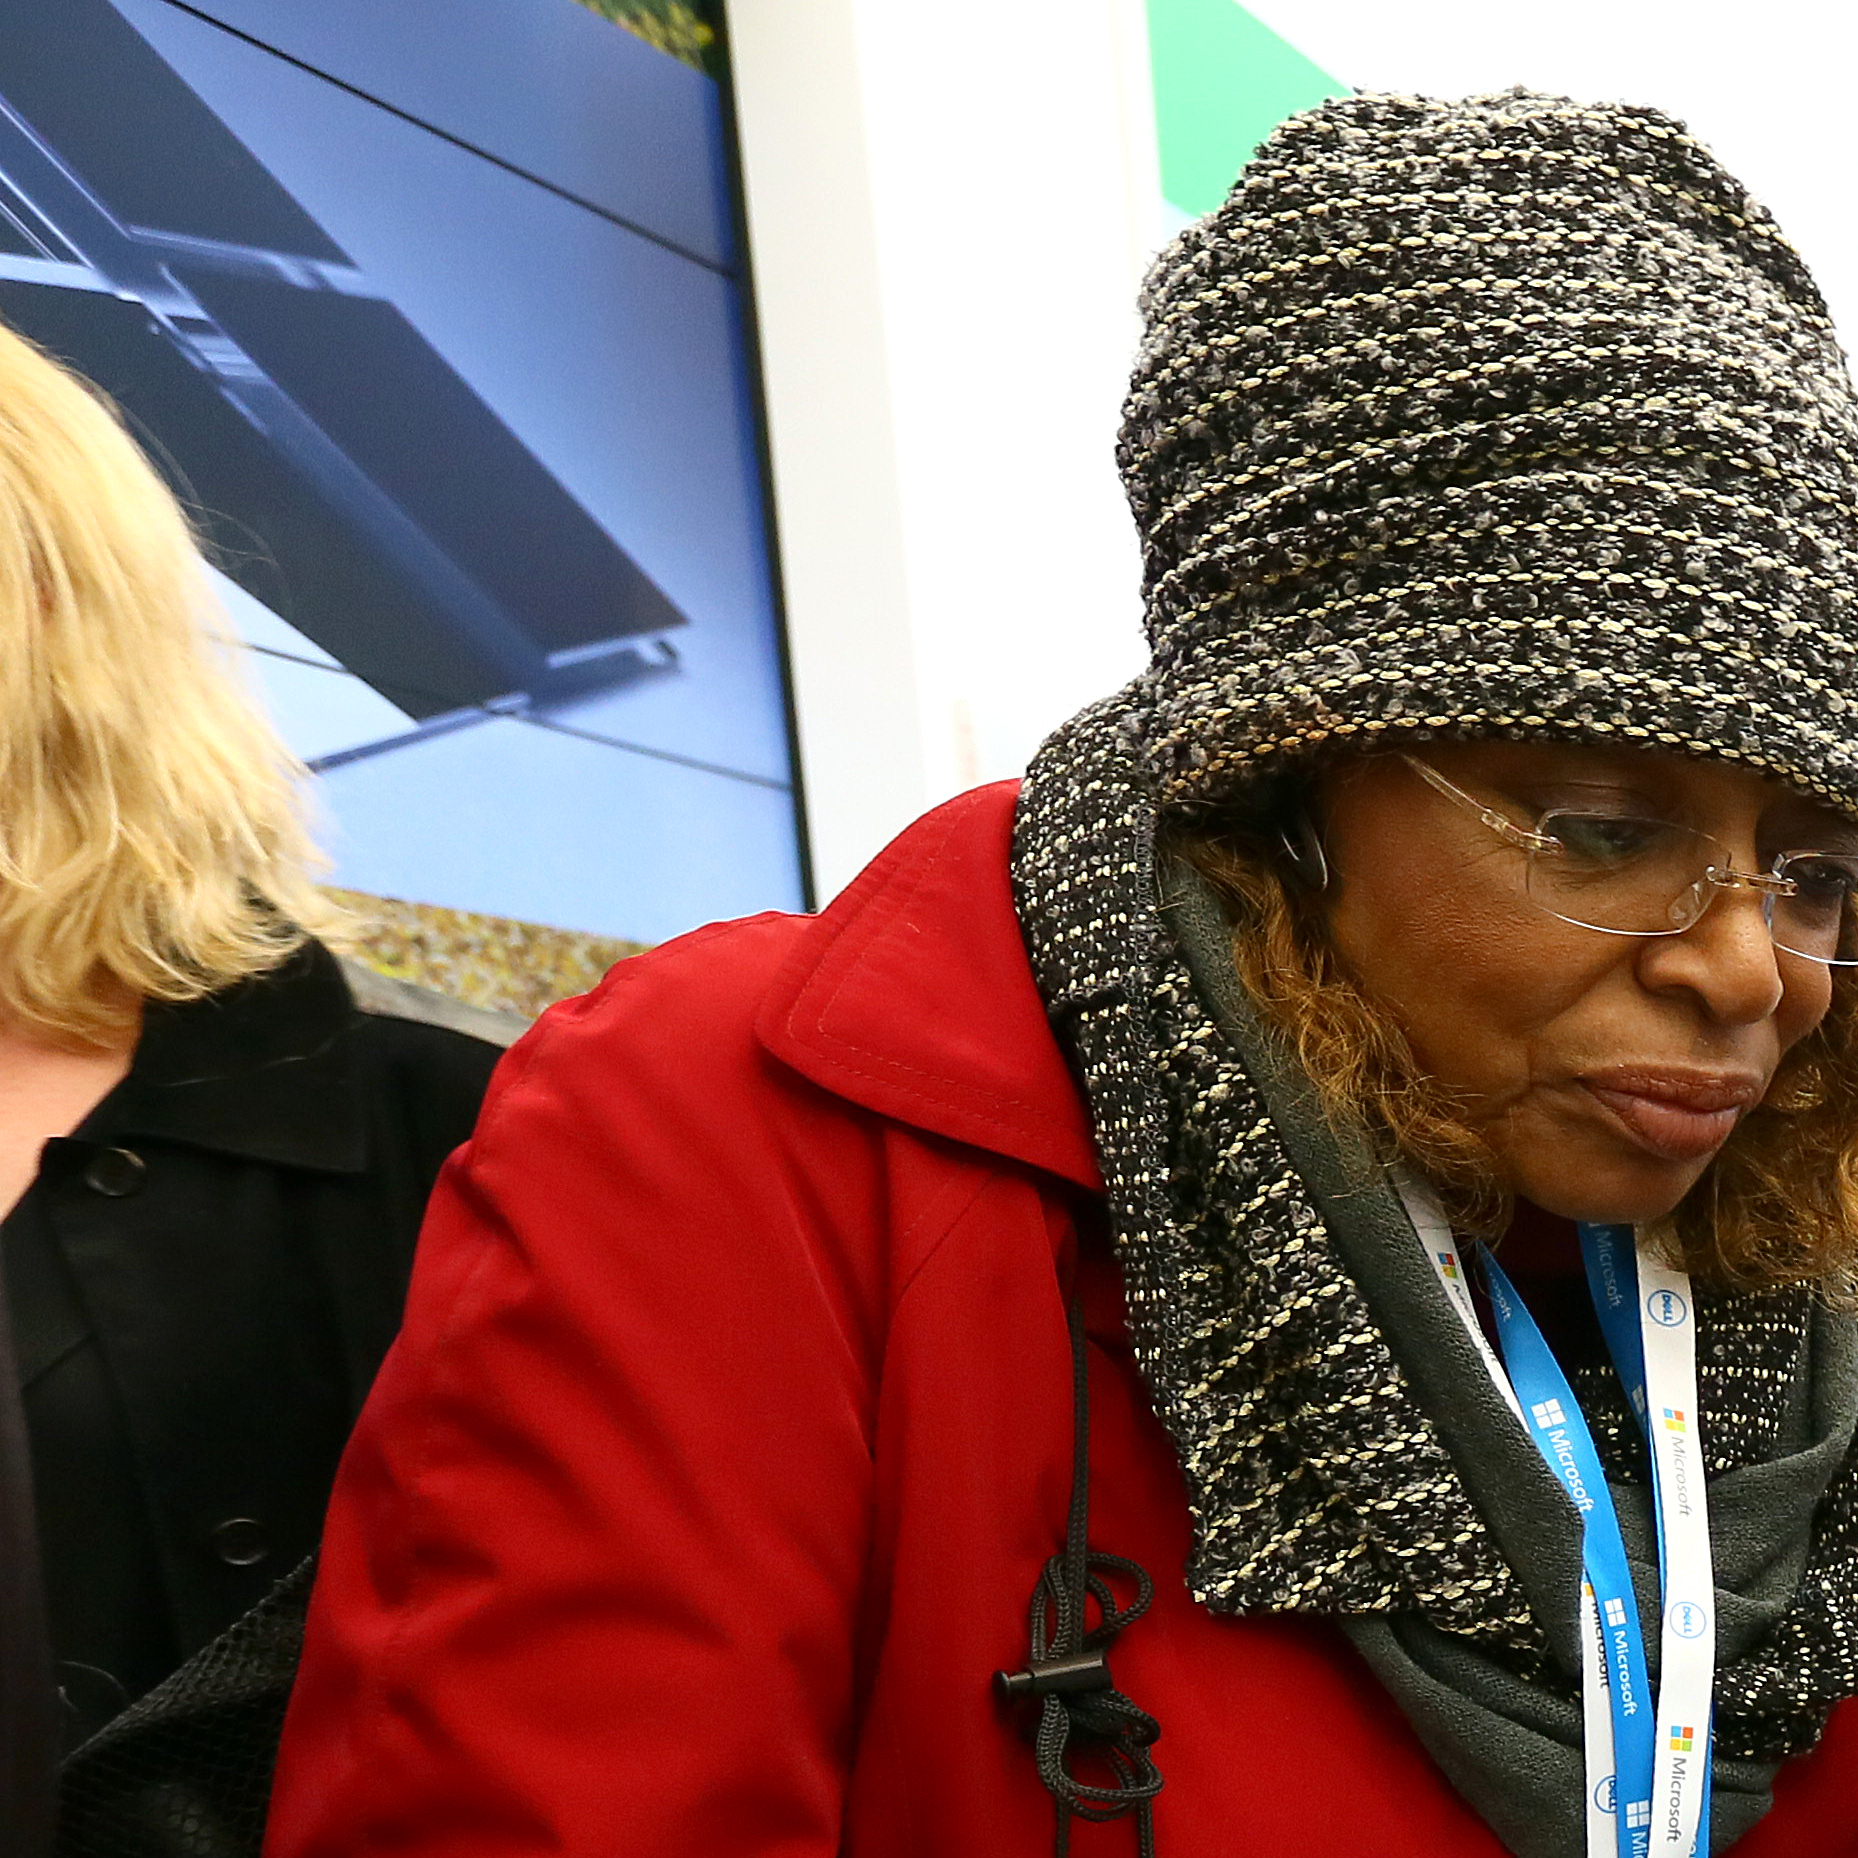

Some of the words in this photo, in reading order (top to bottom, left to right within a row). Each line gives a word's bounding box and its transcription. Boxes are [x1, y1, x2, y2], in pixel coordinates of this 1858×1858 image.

[1547, 1428, 1595, 1513] Microsoft
[1671, 1436, 1692, 1517] Microsoft
[1614, 1630, 1638, 1717] Microsoft
[1666, 1757, 1687, 1842] Microsoft
